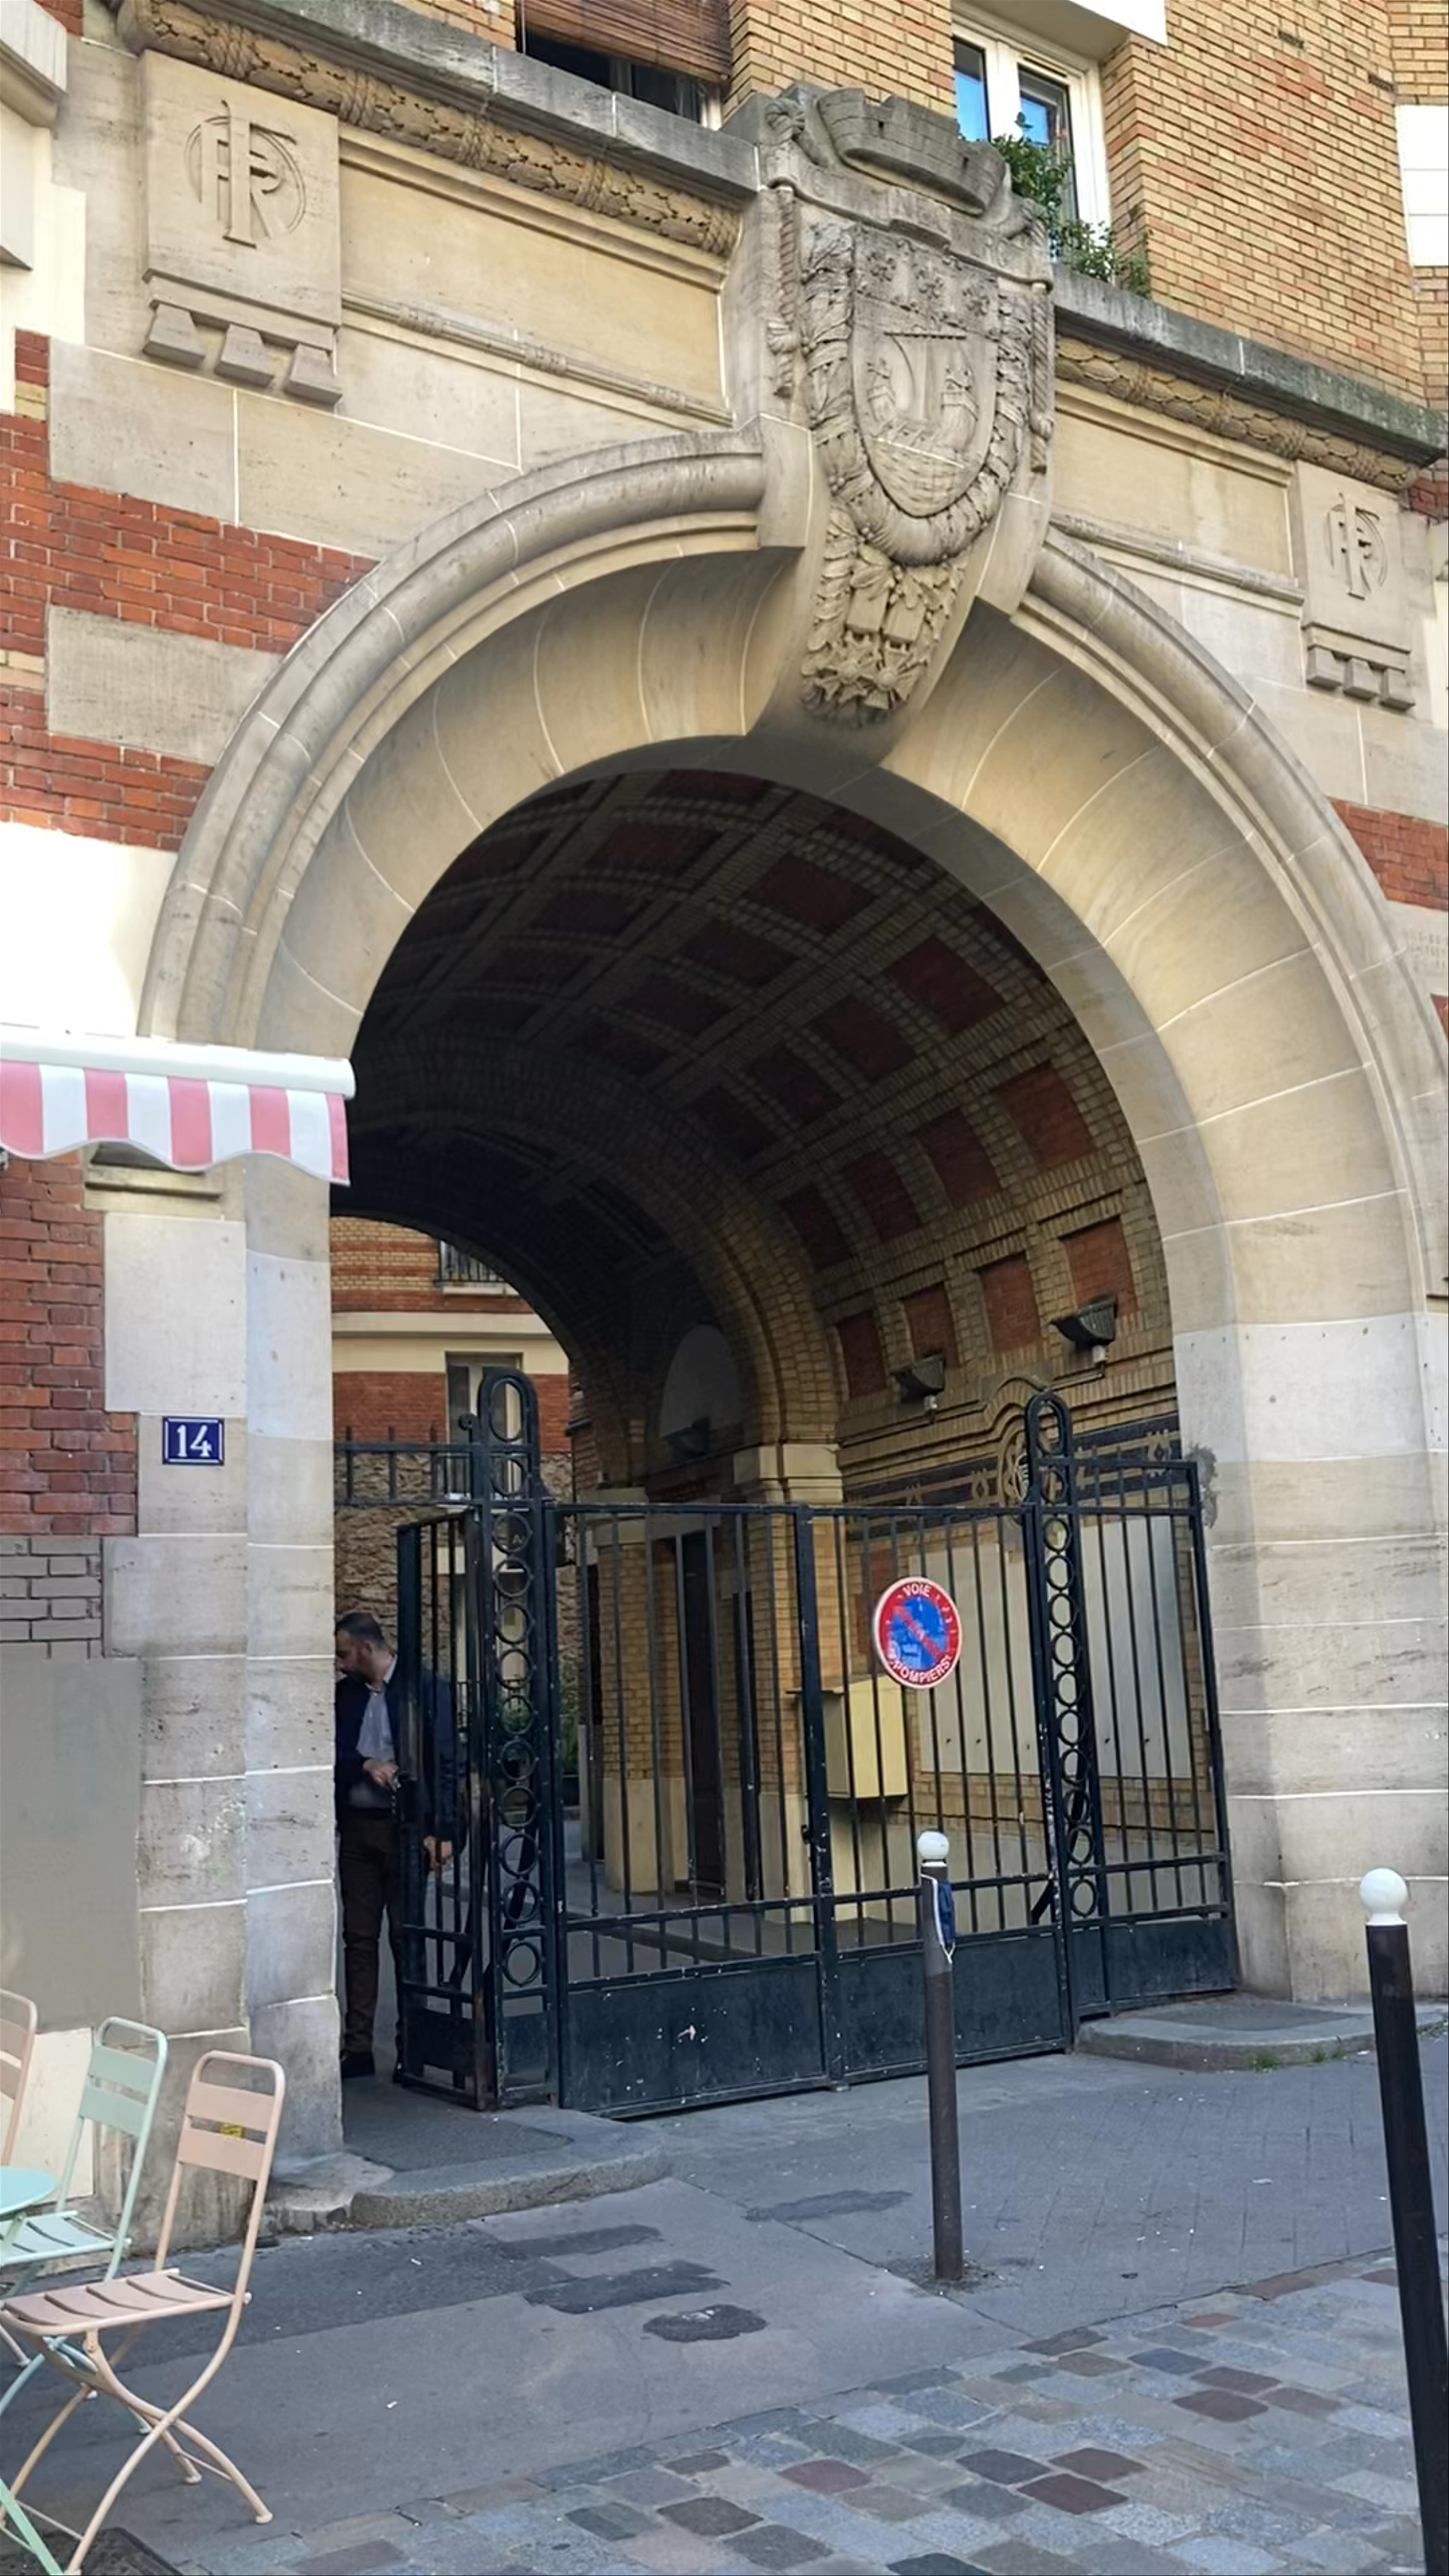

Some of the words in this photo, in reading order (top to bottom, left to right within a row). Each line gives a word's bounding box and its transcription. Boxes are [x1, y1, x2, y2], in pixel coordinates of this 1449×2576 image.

[177, 1424, 212, 1457] 14
[902, 1583, 932, 1598] VOIE
[893, 1655, 952, 1683] POMPIERS
